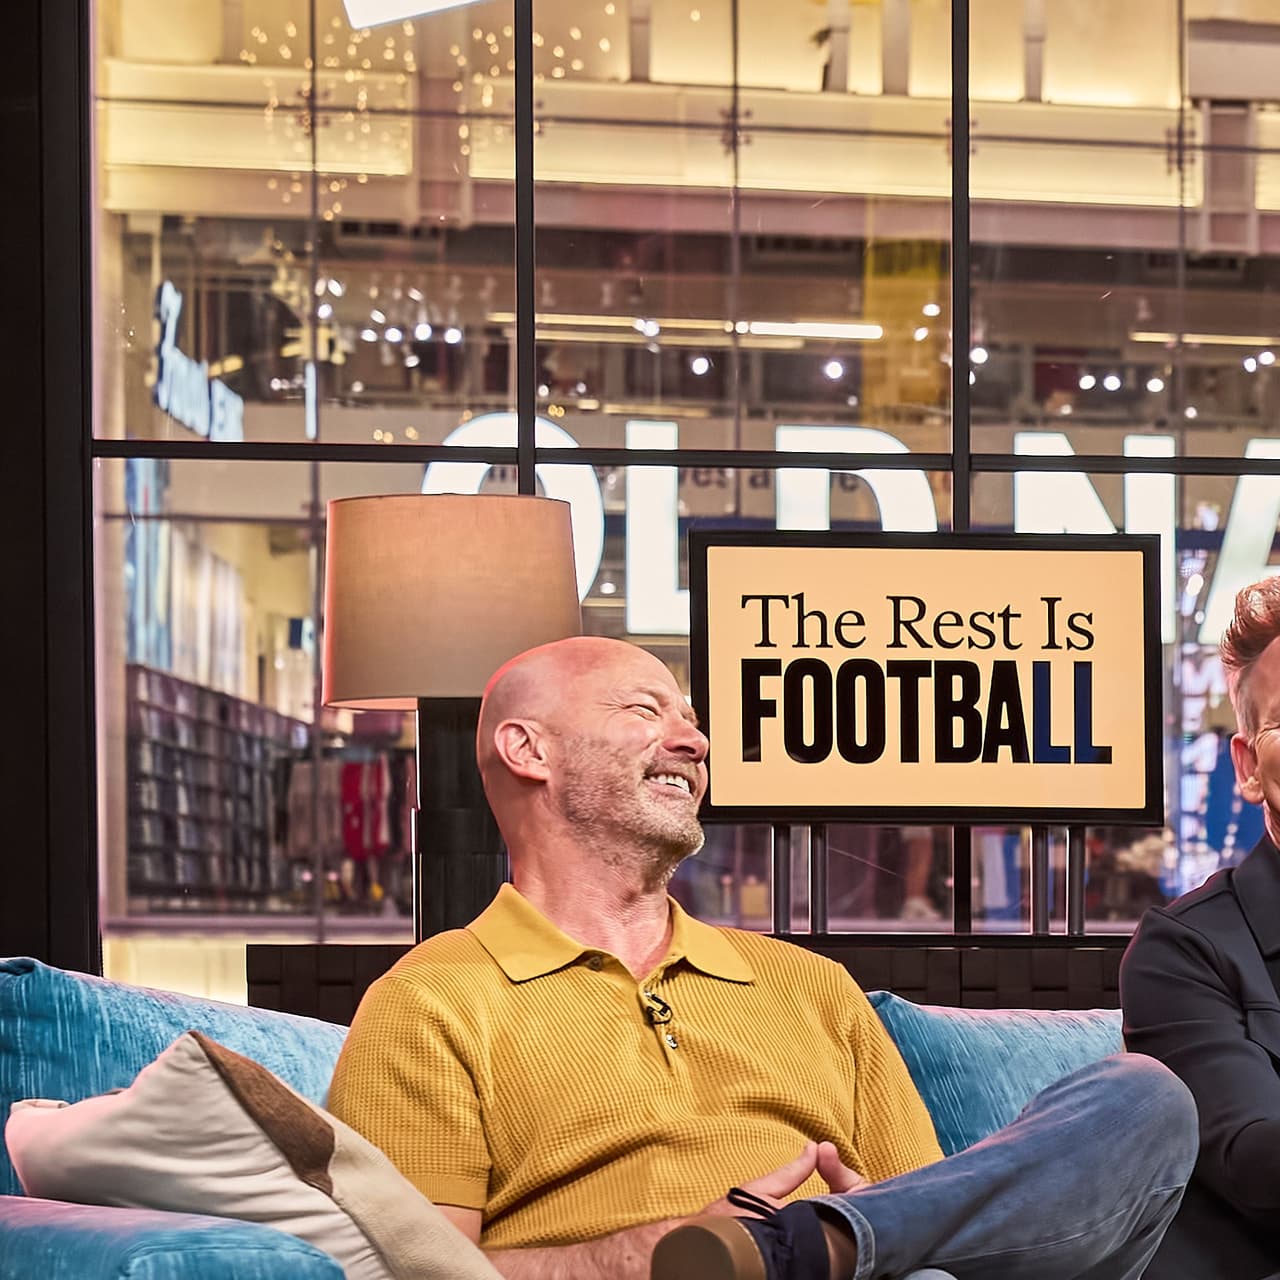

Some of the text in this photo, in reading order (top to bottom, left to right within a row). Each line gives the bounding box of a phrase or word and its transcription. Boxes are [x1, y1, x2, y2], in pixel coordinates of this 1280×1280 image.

[740, 591, 1095, 652] The Rest Is
[740, 657, 1113, 765] FOOTBALL
